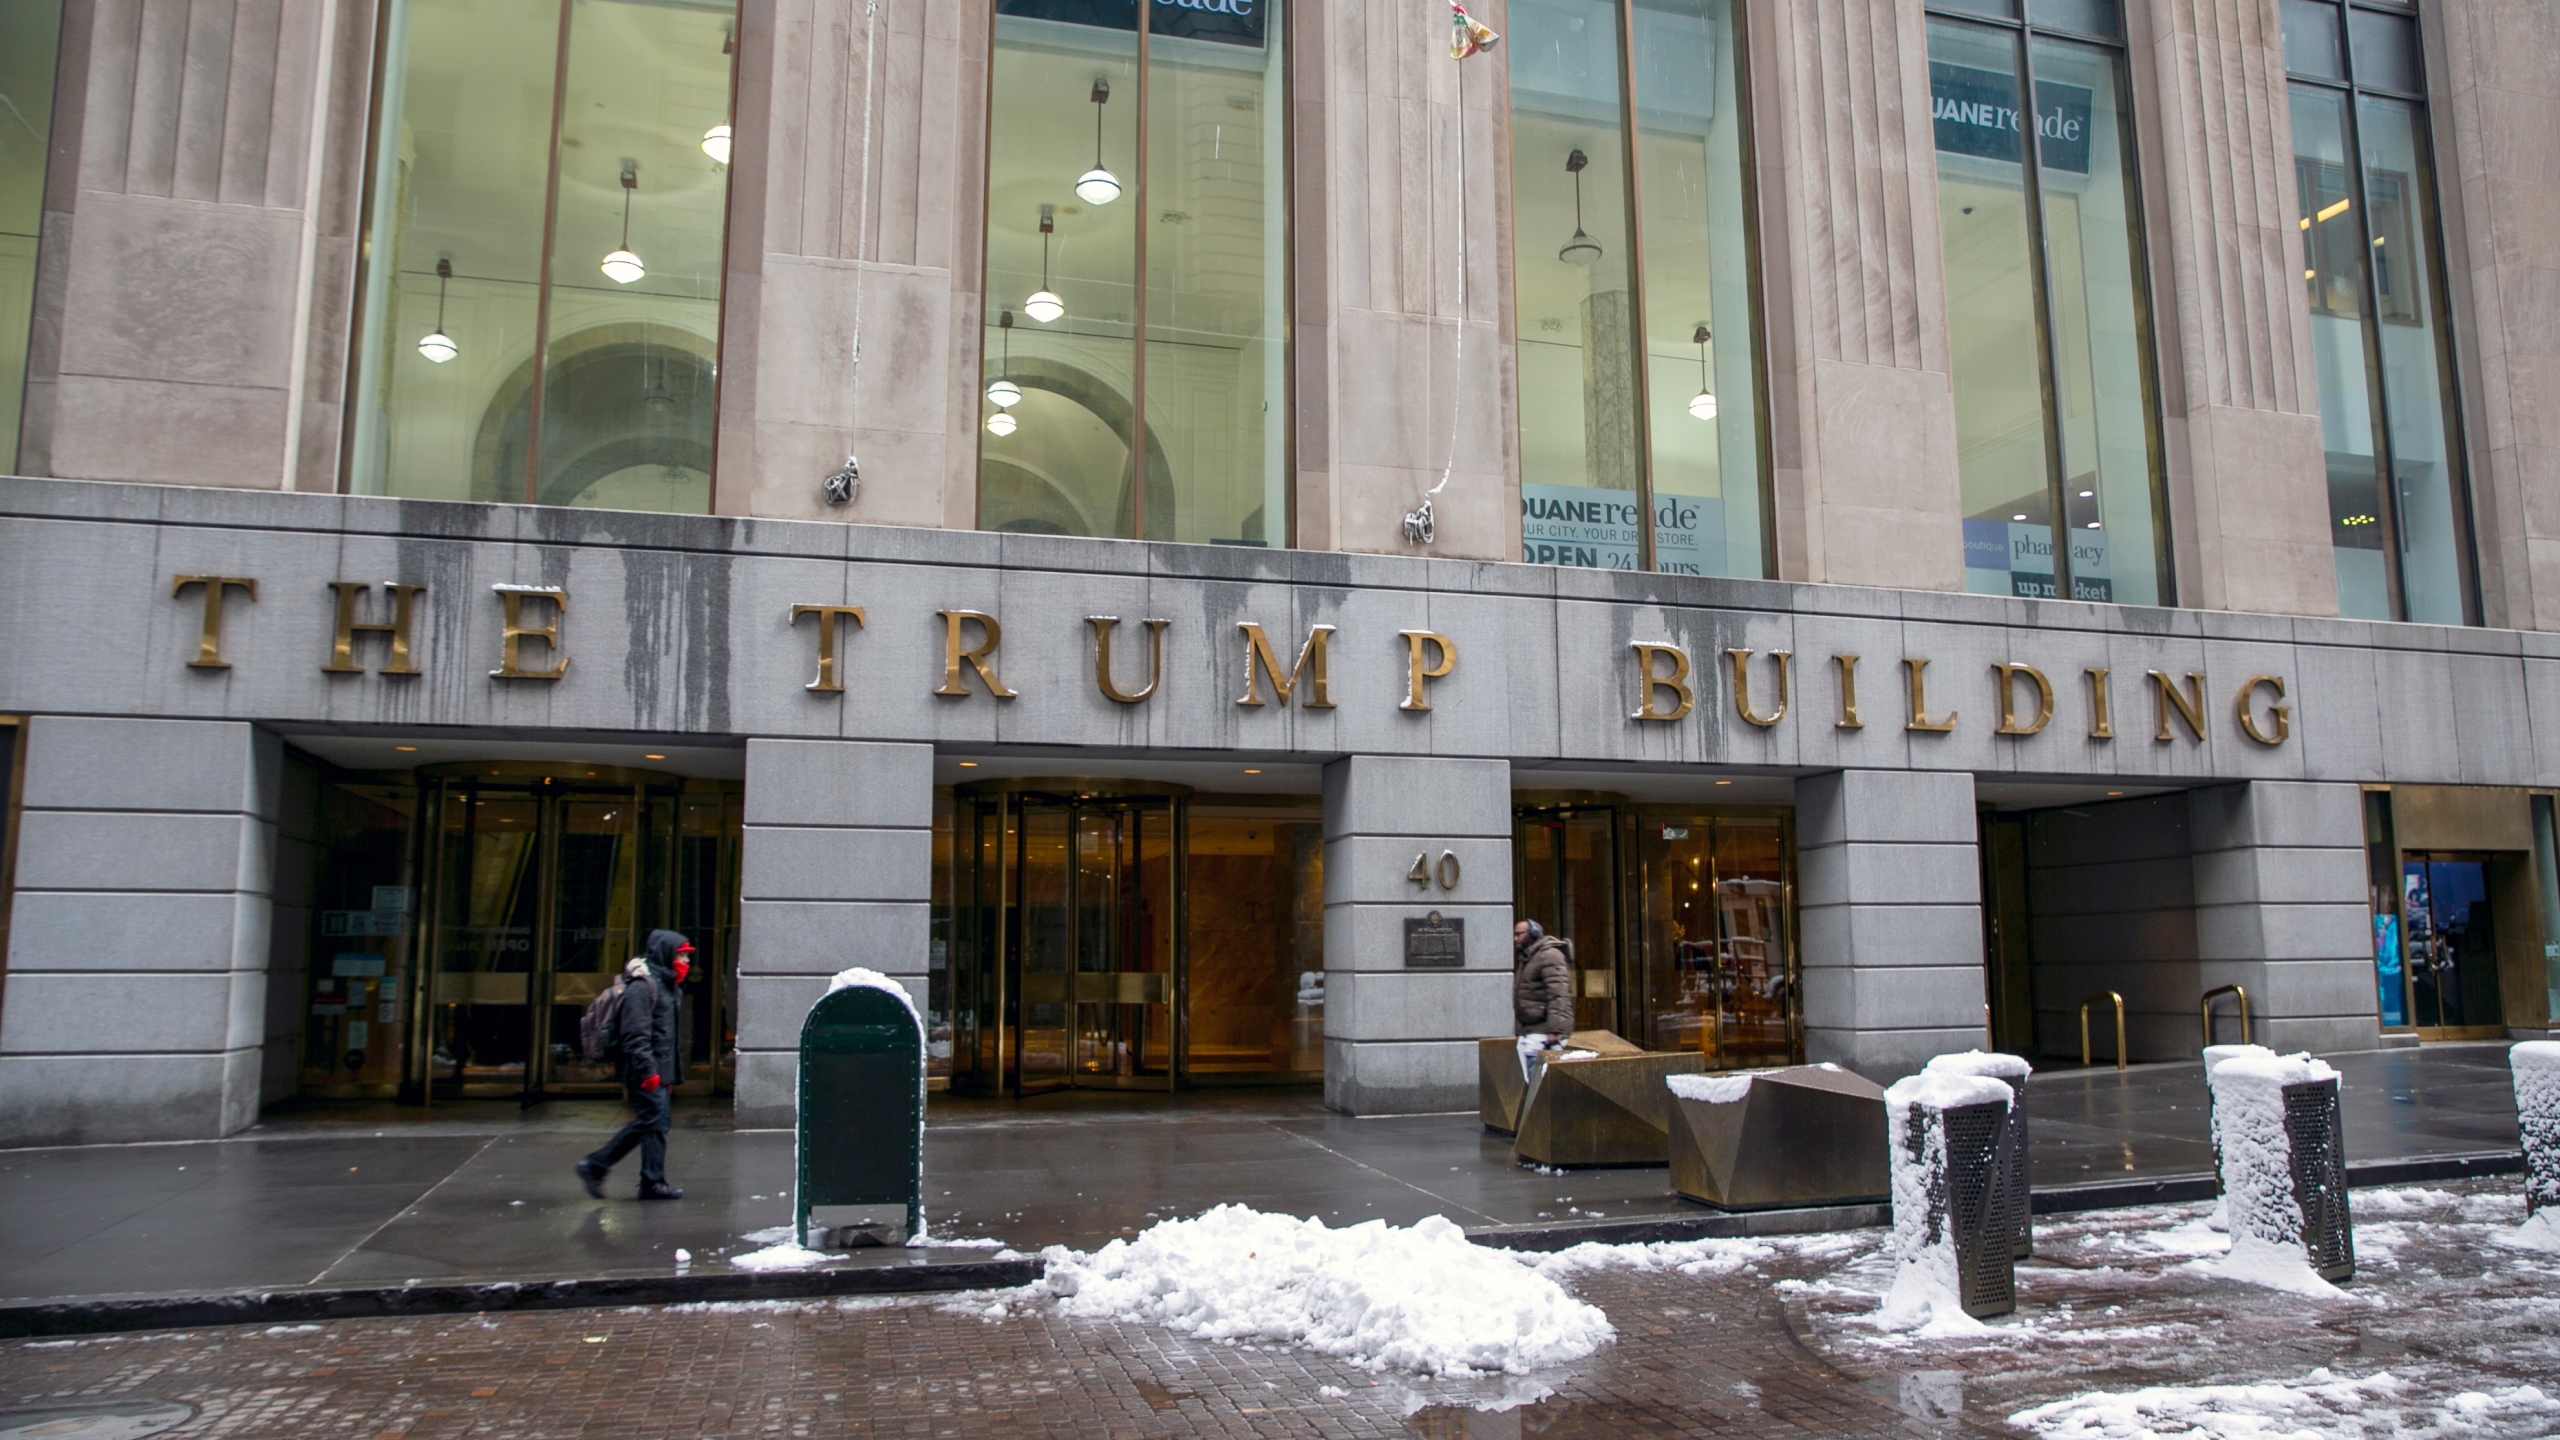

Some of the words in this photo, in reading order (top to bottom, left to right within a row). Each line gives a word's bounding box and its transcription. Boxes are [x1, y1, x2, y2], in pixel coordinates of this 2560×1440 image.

[1549, 525, 1579, 538] CITY.
[1584, 528, 1617, 541] YOUR
[1622, 530, 1699, 547] DRSTORE.
[1608, 553, 1633, 571] 24
[2013, 534, 2104, 567] phaacy
[2017, 582, 2040, 598] up
[172, 574, 571, 680] THE
[790, 602, 1458, 711] TRUMP
[1629, 640, 2291, 745] BUILDING
[1408, 850, 1460, 889] 40
